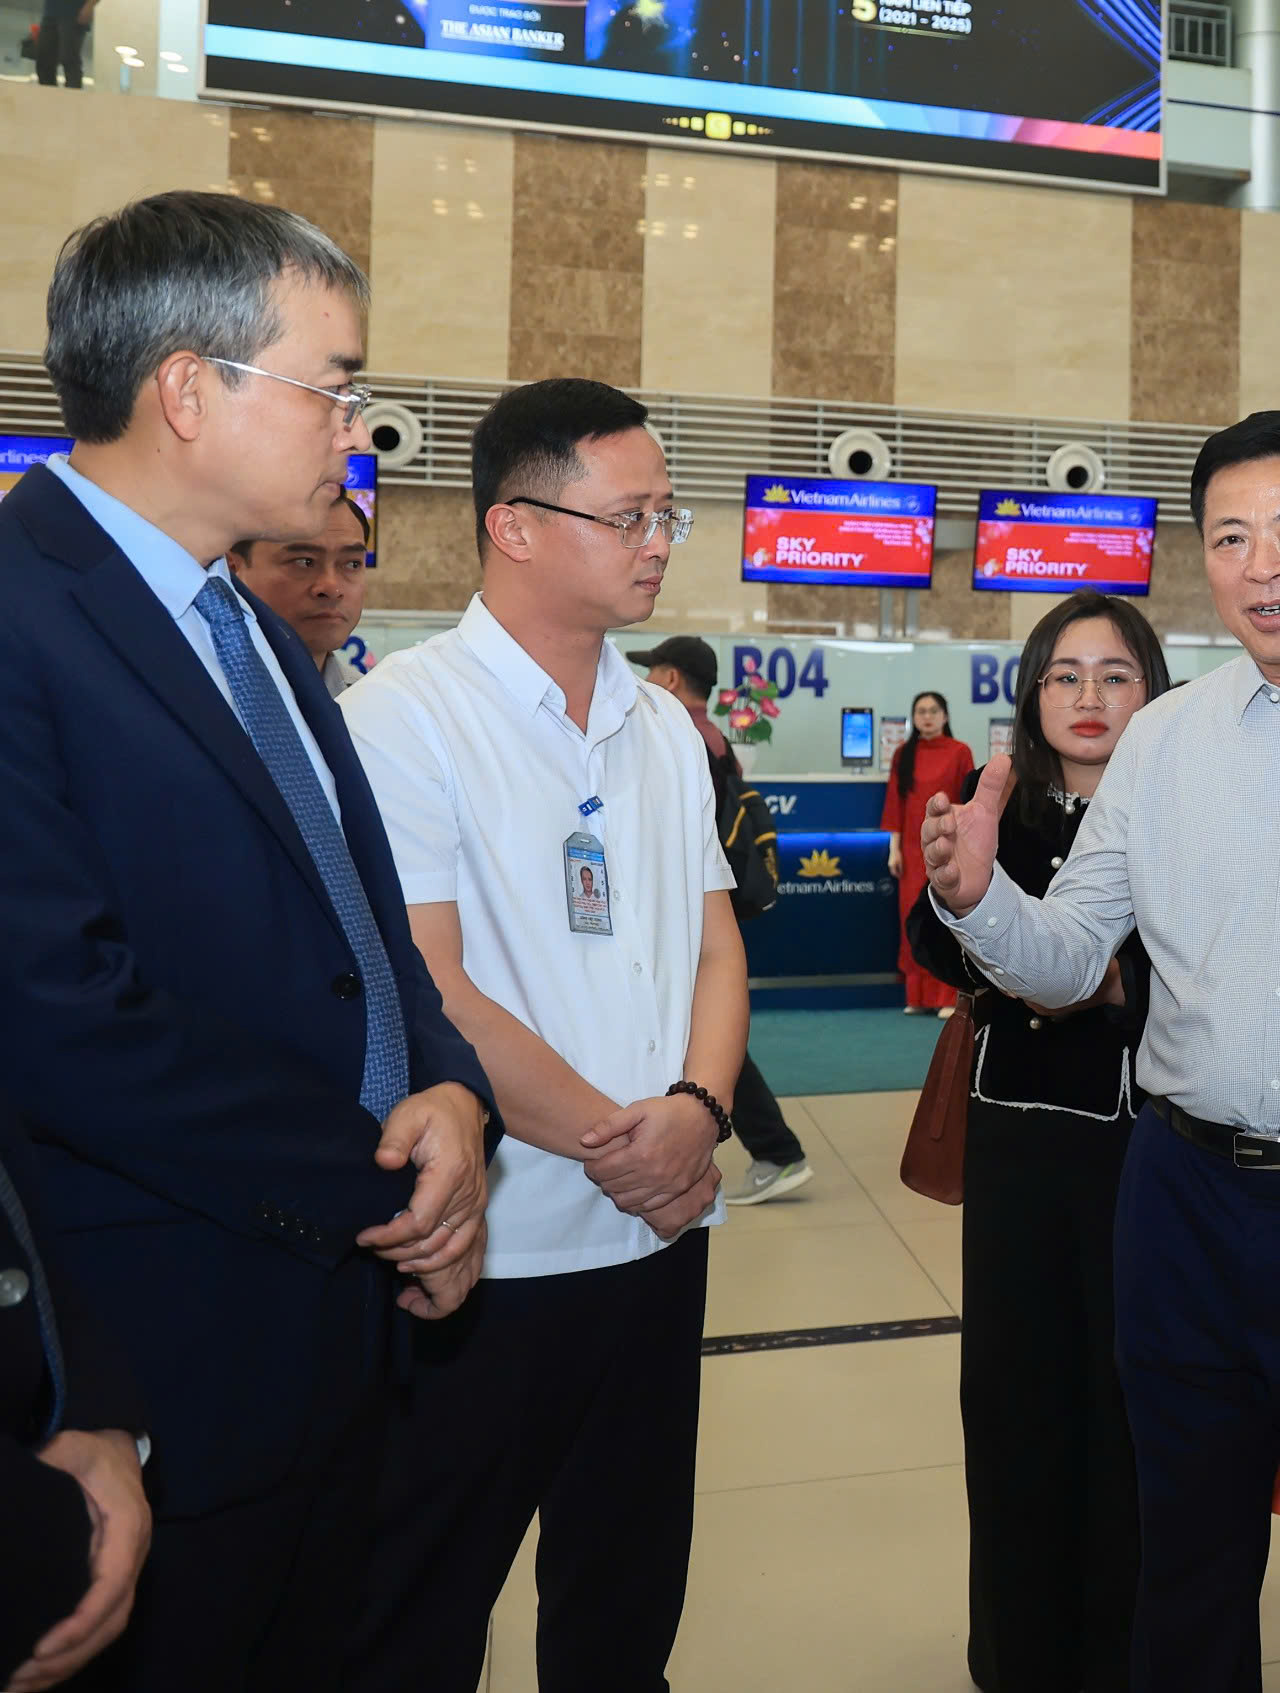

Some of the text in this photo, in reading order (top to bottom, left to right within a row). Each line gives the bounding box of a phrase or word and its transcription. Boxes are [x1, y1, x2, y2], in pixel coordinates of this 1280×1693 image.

[776, 535, 816, 552] SKY
[775, 550, 865, 568] PRIORITY
[1006, 547, 1044, 563] SKY
[1005, 560, 1089, 577] PRIORITY
[970, 652, 1018, 706] B0
